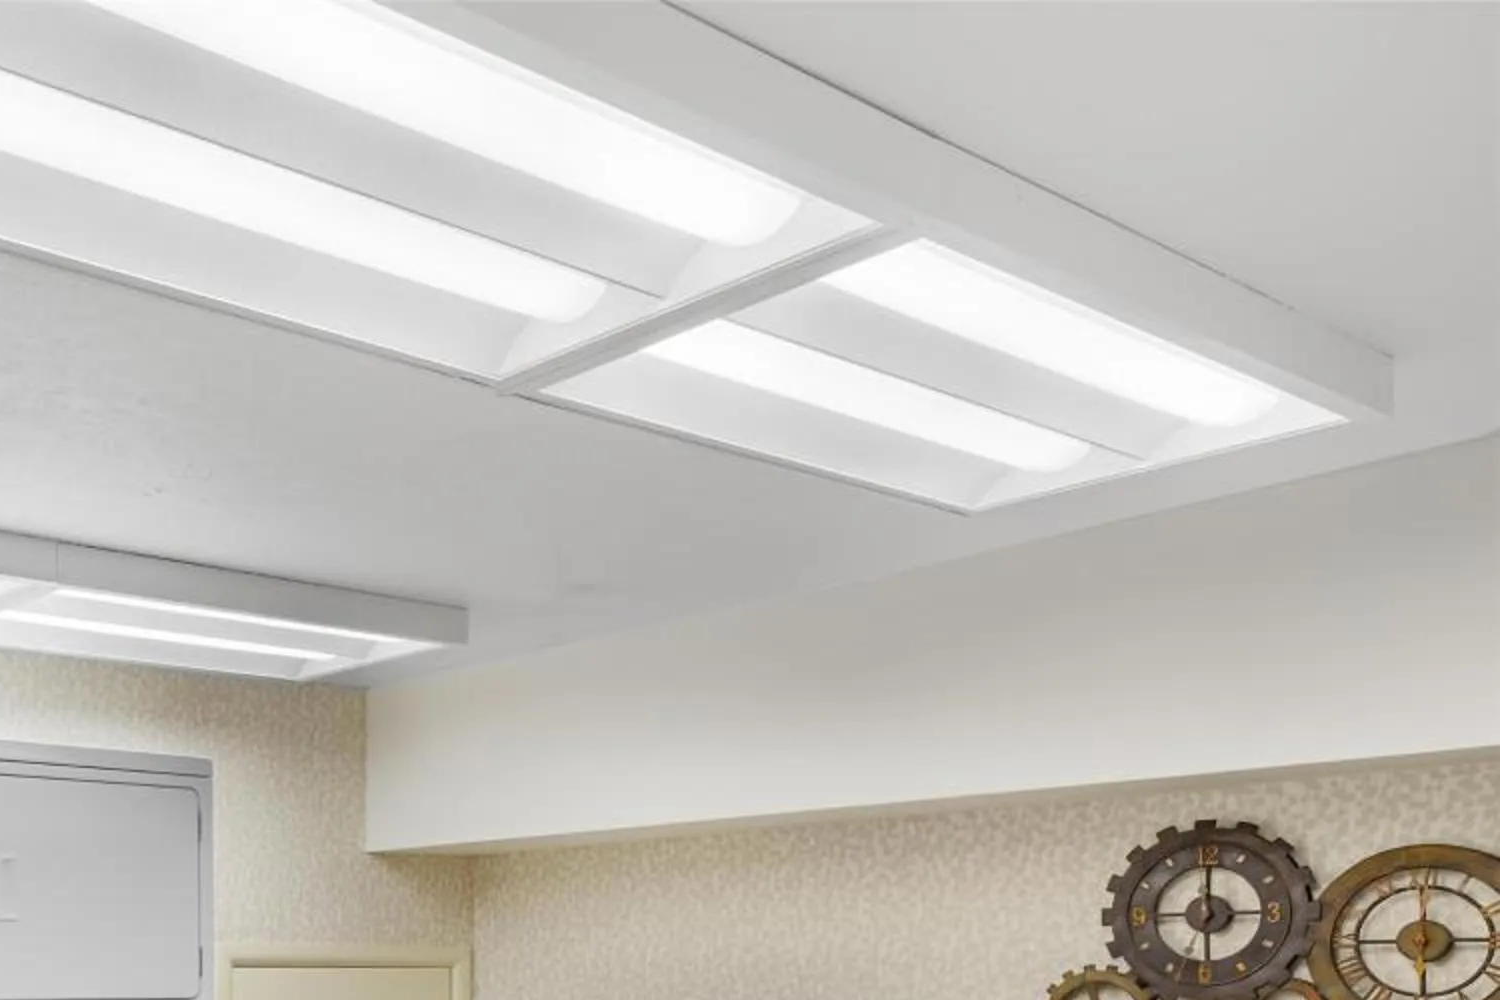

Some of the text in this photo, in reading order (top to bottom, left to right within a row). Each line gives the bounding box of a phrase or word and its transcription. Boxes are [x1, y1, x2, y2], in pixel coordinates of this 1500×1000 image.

[1198, 845, 1219, 866] 12
[1132, 907, 1145, 927] 9
[1266, 901, 1281, 923] 3
